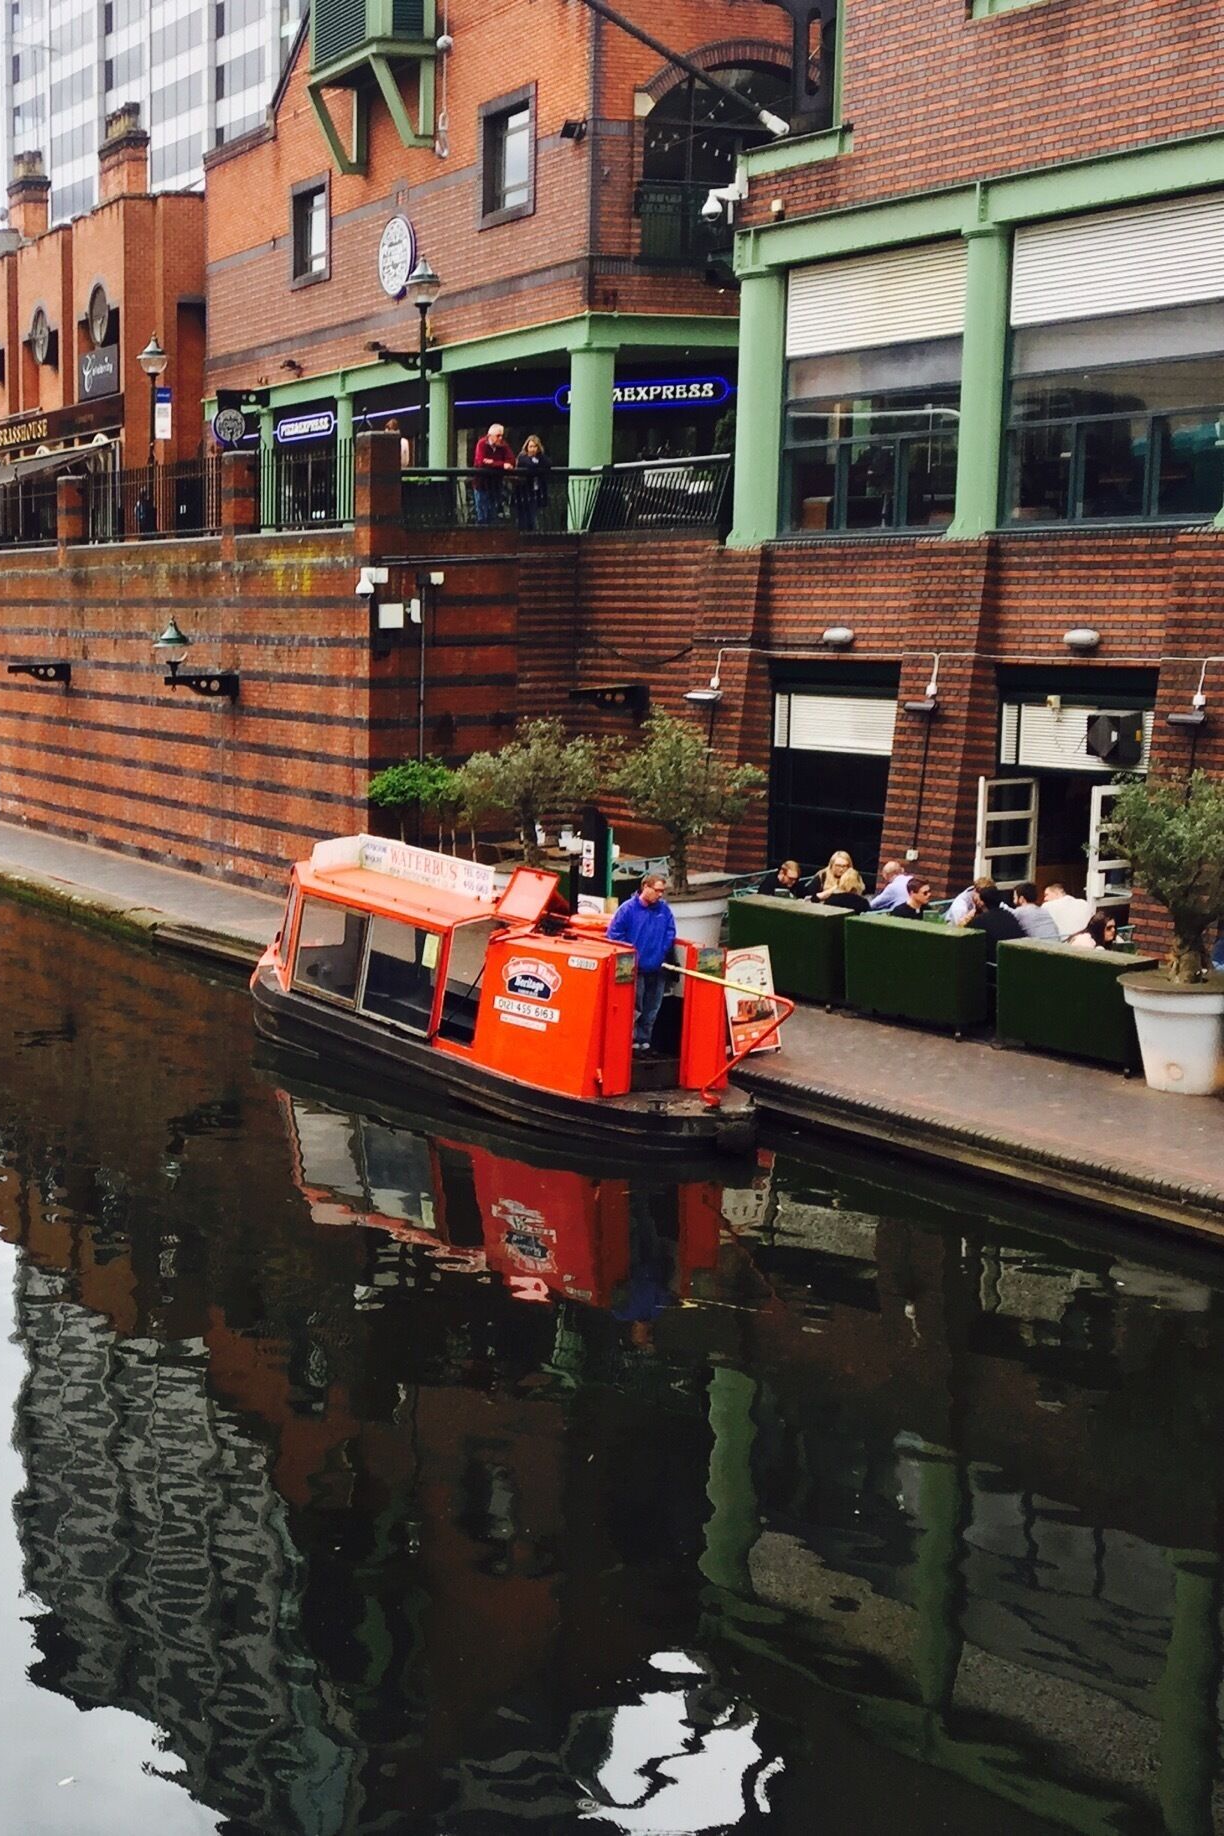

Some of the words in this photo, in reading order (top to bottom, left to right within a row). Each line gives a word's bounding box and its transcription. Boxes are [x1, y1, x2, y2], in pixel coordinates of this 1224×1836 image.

[567, 383, 714, 404] AEXPRESS
[390, 847, 458, 880] WATERBUS
[514, 975, 545, 992] Heritage
[498, 999, 514, 1010] 0121
[517, 1003, 531, 1015] 455
[534, 1009, 554, 1020] 6163
